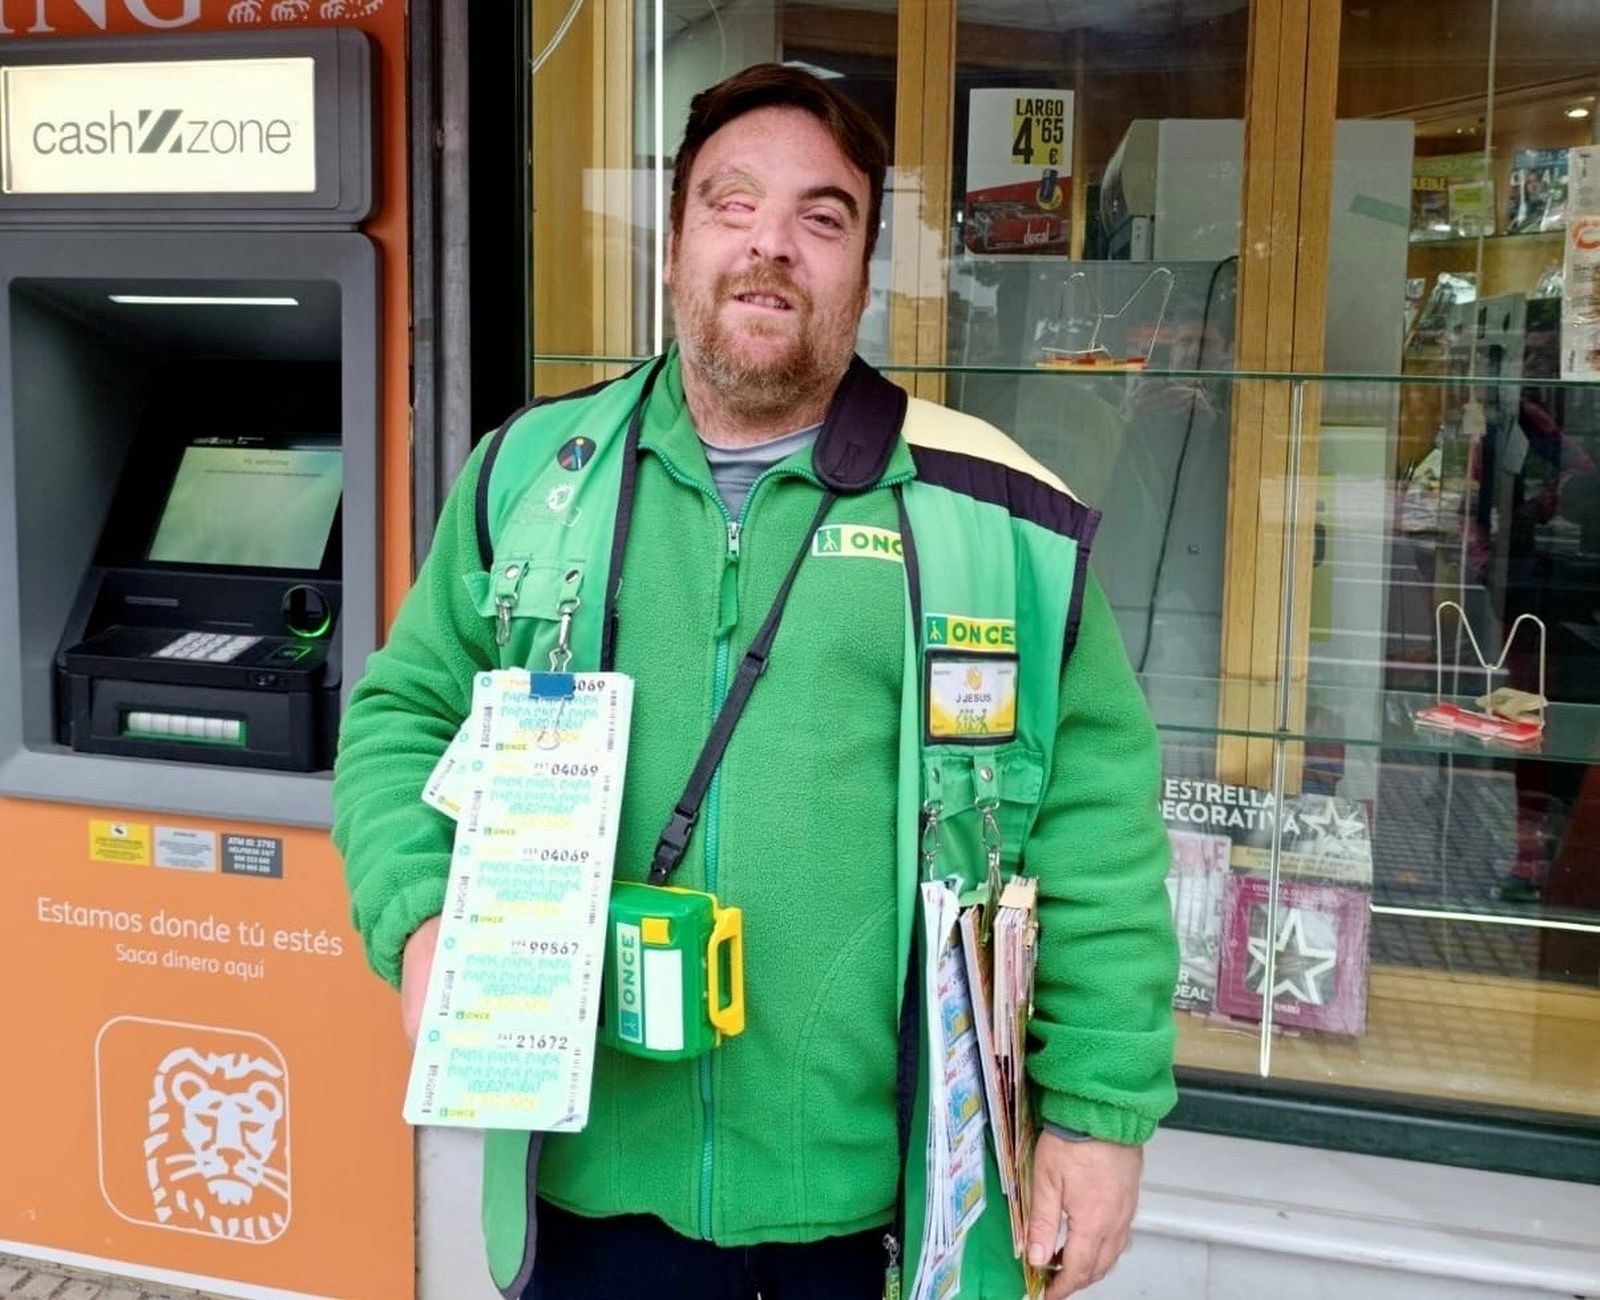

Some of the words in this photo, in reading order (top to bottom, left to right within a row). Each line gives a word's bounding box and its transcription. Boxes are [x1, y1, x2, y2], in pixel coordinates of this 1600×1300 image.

[1016, 98, 1064, 116] LARGO
[1048, 148, 1059, 165] €
[952, 622, 1016, 645] ONCE
[963, 693, 992, 703] JESUS
[551, 763, 599, 776] 04069
[1165, 780, 1276, 807] ESTRELLA
[1158, 800, 1301, 834] ECORATIVA
[540, 849, 590, 862] 04069
[37, 896, 143, 933] Estamos
[149, 910, 231, 944] donde
[237, 921, 265, 947] tú
[273, 929, 344, 957] estés
[115, 943, 157, 966] Saca
[162, 951, 219, 974] dinero
[224, 959, 265, 982] aquí
[622, 934, 635, 1005] ONCE
[516, 1034, 569, 1050] 21672
